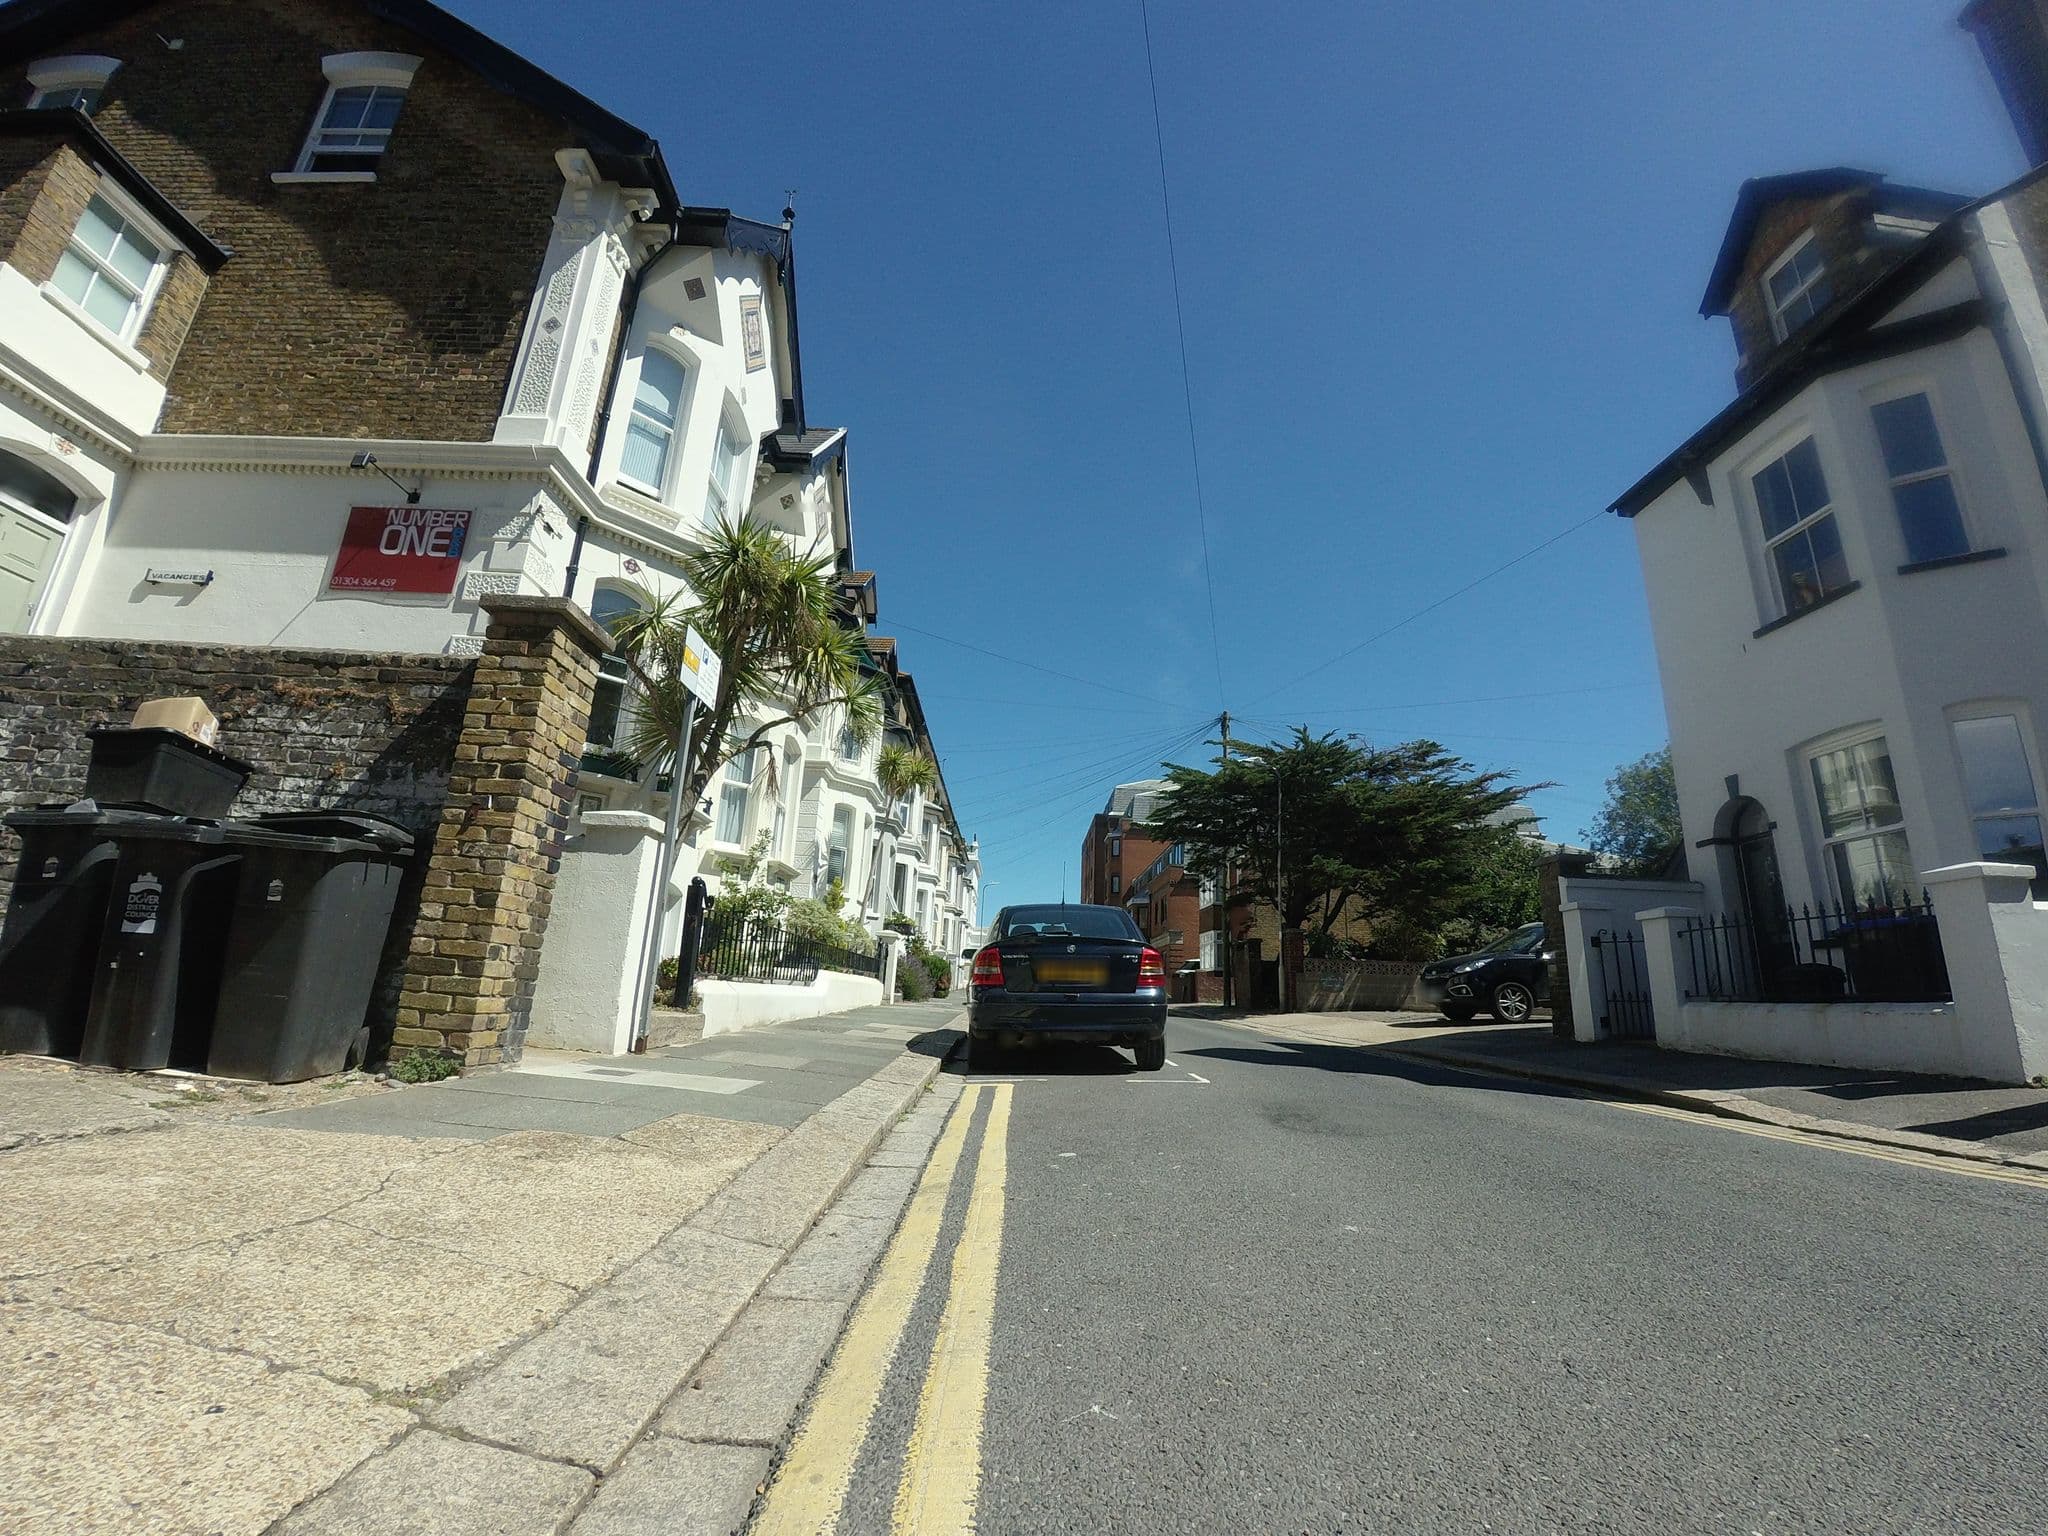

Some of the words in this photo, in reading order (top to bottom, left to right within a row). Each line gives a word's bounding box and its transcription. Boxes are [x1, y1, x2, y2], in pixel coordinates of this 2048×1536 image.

[387, 509, 468, 527] NUMBER
[379, 525, 453, 557] ONE
[331, 576, 360, 586] 01304
[360, 577, 378, 586] 364
[379, 578, 397, 587] 459
[128, 894, 159, 904] DOVER
